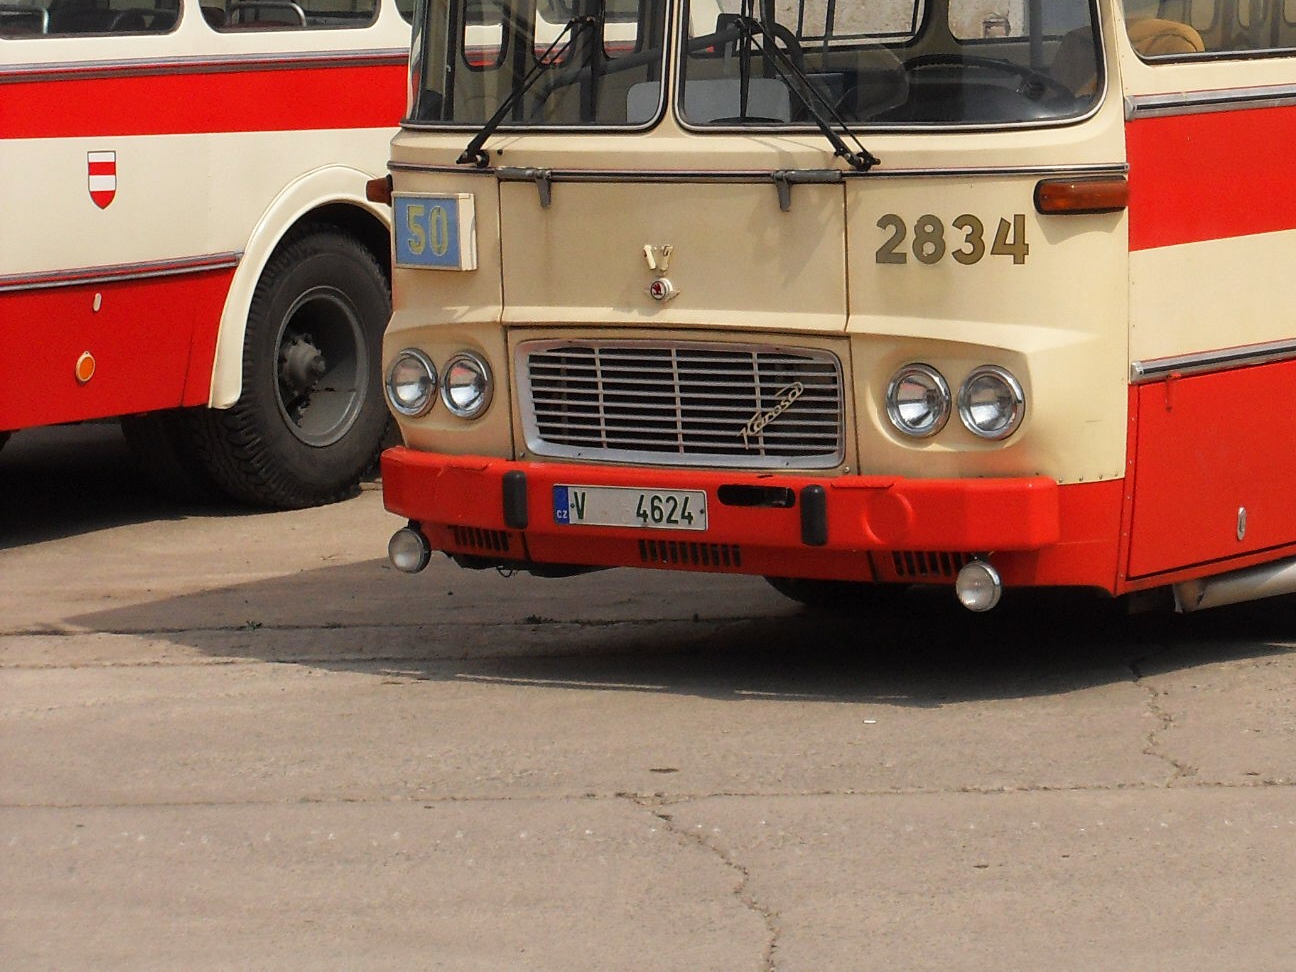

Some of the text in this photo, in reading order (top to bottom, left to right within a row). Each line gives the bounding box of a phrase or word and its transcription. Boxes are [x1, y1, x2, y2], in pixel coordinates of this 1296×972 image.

[407, 204, 448, 257] 50
[875, 213, 1029, 265] 2834
[556, 509, 568, 519] CZ
[574, 491, 694, 525] V 4624
